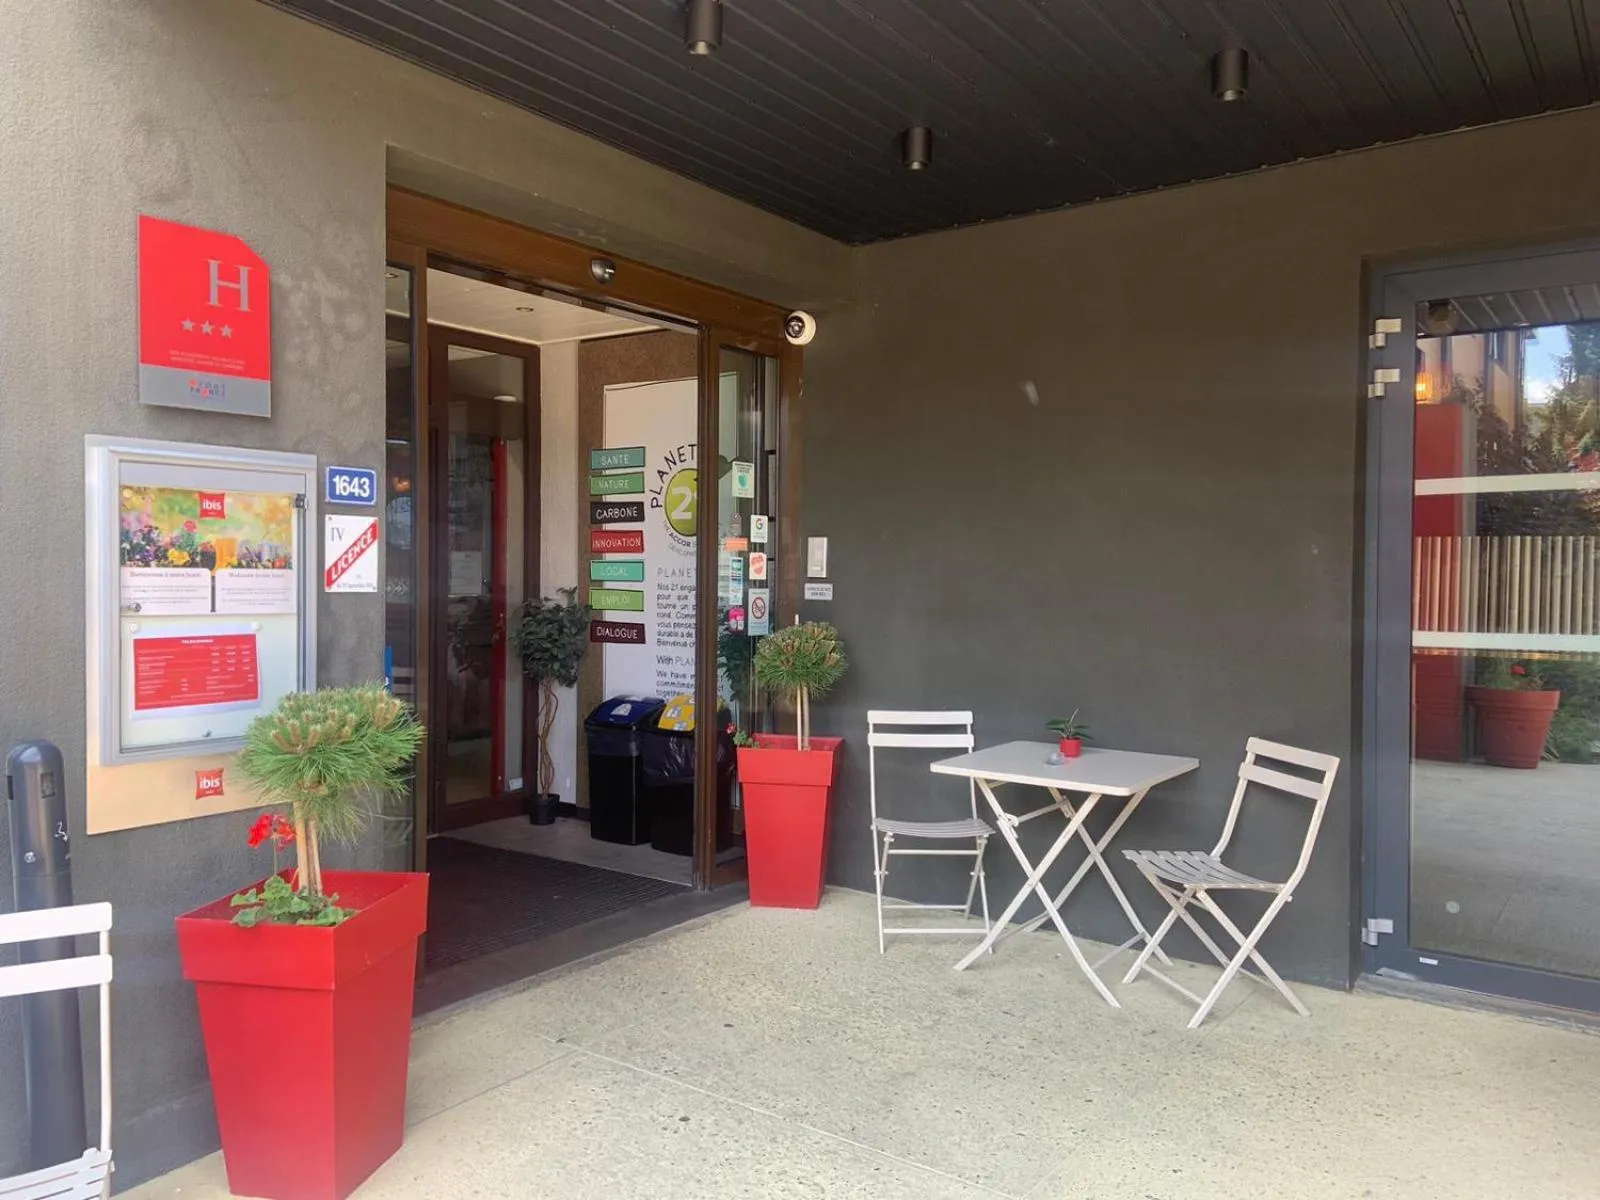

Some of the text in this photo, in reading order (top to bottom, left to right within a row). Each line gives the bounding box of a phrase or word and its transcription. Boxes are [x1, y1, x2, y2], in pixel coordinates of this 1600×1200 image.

[204, 258, 255, 313] H
[649, 443, 697, 509] PLANET
[331, 474, 370, 498] 1643
[599, 479, 629, 490] NATURE
[203, 499, 221, 511] ibis
[672, 485, 697, 520] 2
[595, 506, 639, 520] CARBONE
[331, 527, 345, 542] IV
[592, 537, 641, 549] INNOVATION
[331, 527, 373, 580] LICENCE
[600, 566, 628, 576] LOCAL
[657, 567, 697, 578] PLANE
[596, 626, 638, 640] DIALOGUE
[200, 776, 221, 789] ibis
